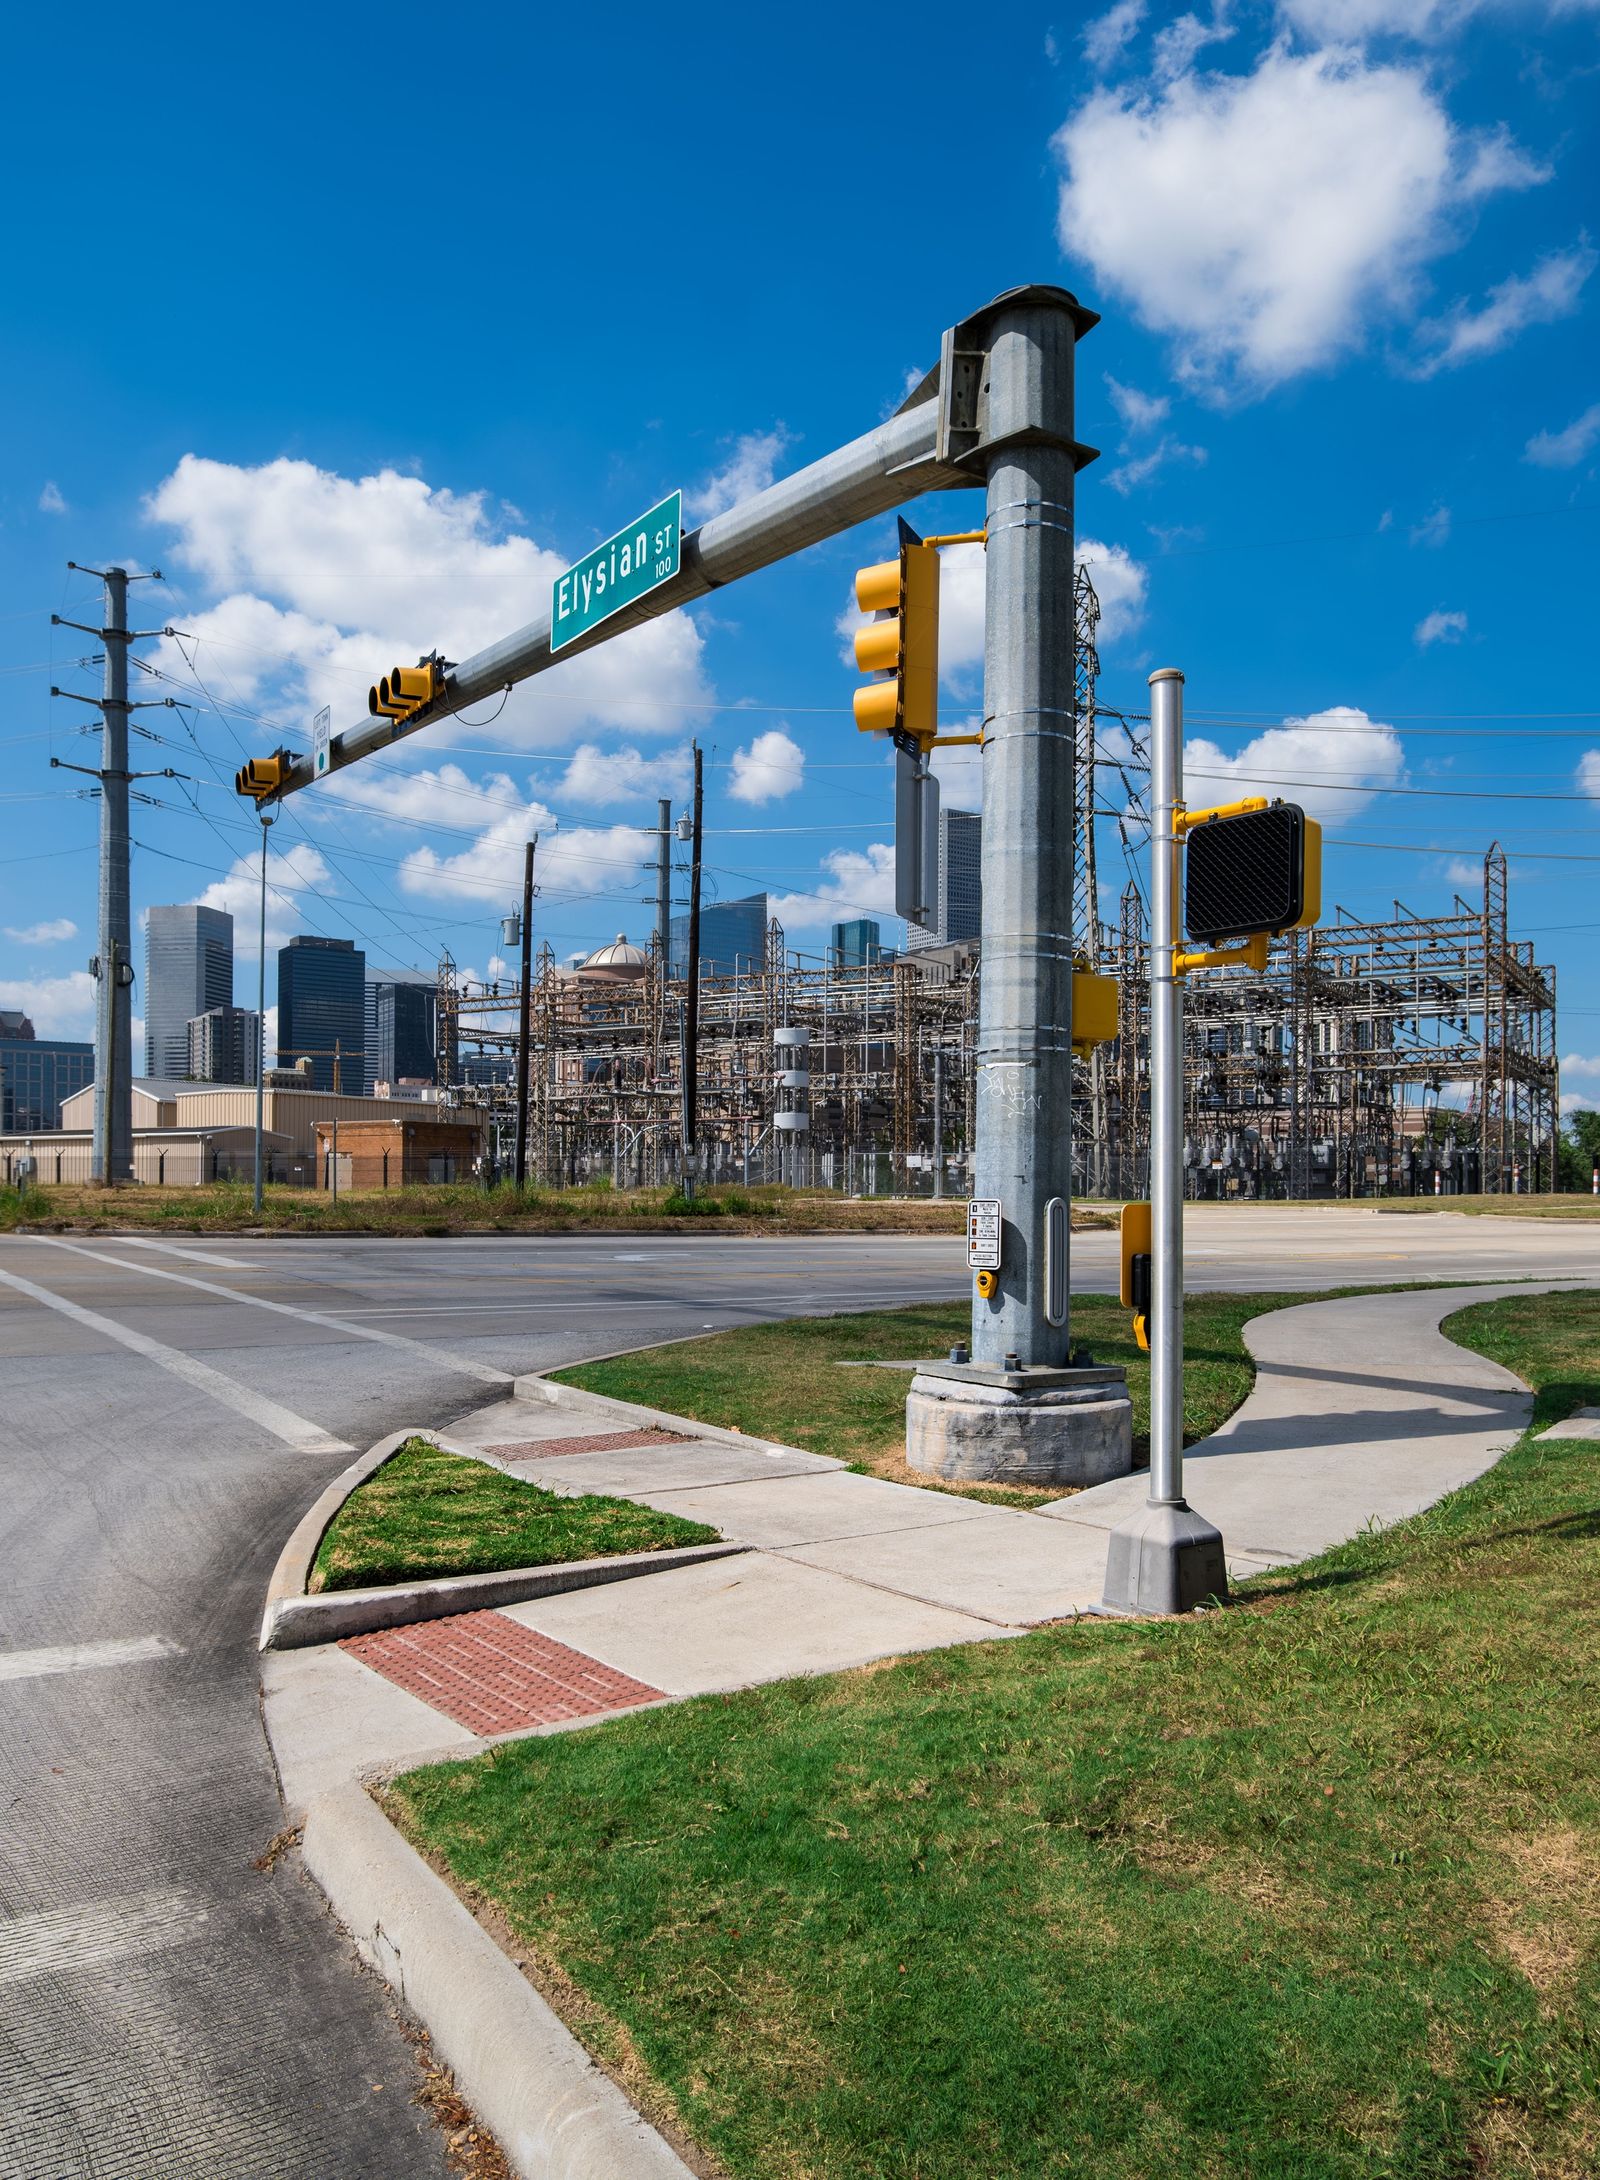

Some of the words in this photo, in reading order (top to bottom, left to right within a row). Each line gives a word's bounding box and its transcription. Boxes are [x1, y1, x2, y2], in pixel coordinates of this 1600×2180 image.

[558, 532, 647, 621] Elysian
[655, 524, 672, 554] ST
[655, 556, 671, 579] 100
